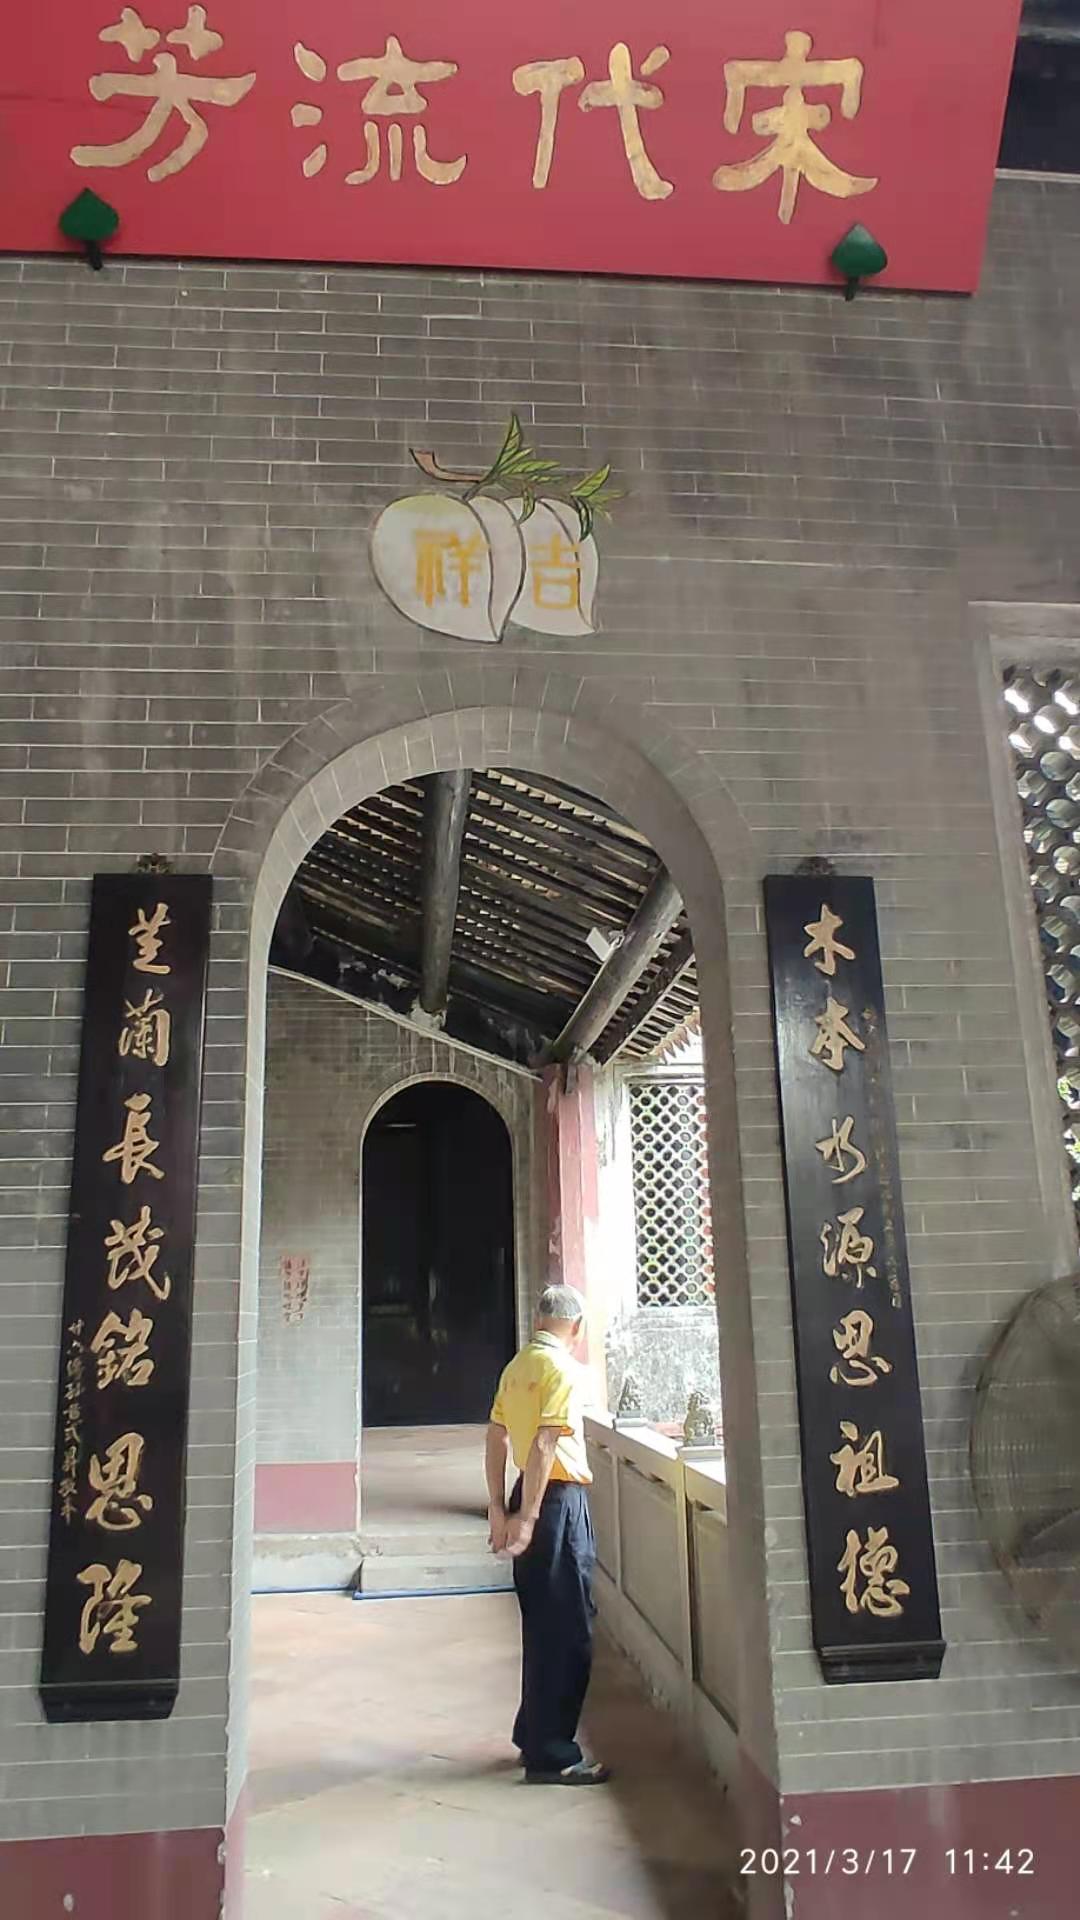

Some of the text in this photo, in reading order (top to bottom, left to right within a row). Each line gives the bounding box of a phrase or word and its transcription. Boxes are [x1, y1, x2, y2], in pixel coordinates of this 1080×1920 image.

[70, 4, 879, 225] 宋代流芳
[413, 529, 582, 611] 吉祥
